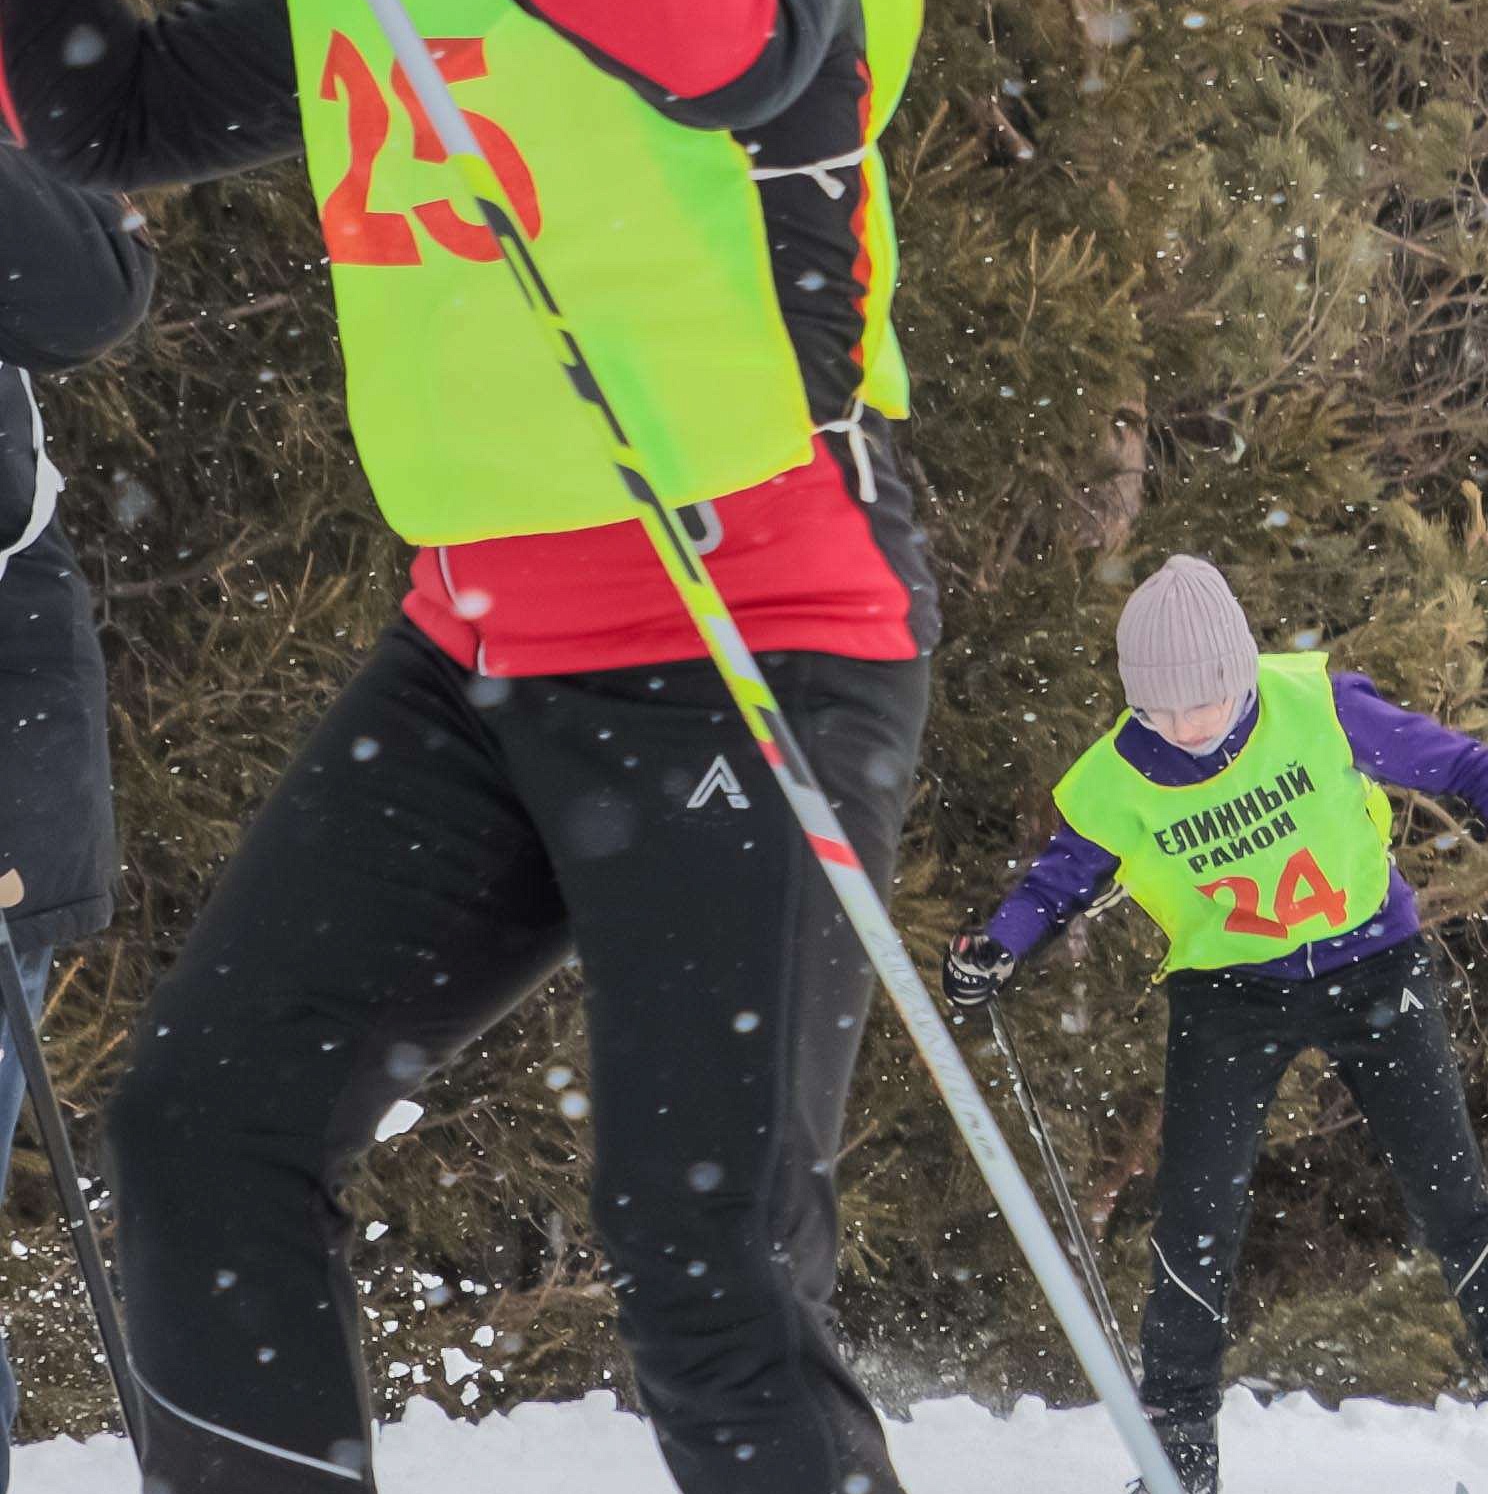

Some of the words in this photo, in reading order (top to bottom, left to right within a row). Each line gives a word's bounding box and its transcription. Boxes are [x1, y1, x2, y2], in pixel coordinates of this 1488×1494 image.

[319, 28, 542, 266] 25
[1186, 810, 1298, 875] РАЙОН
[1194, 847, 1347, 939] 24
